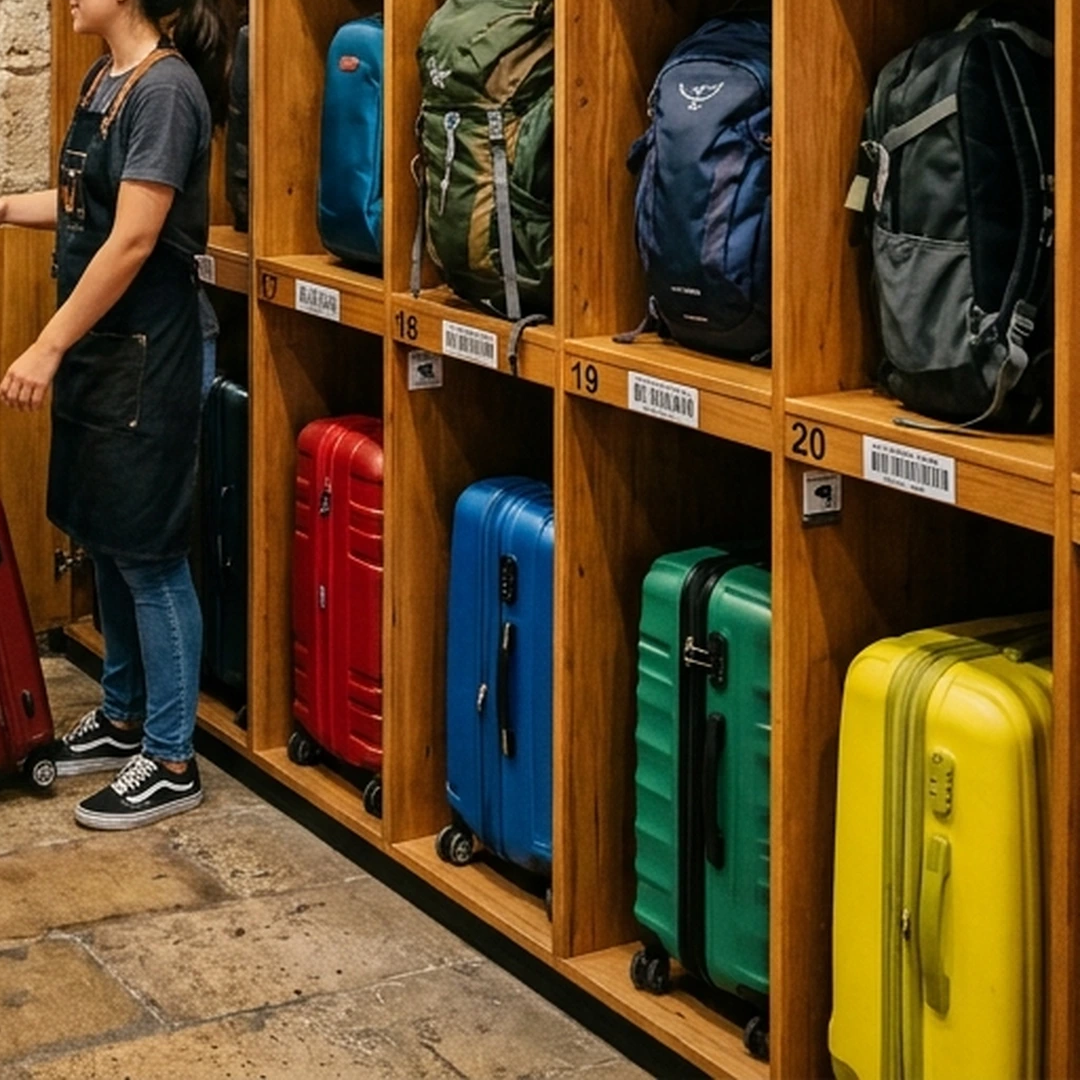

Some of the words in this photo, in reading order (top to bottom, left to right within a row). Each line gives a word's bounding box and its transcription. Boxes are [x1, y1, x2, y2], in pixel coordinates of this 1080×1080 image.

[395, 309, 418, 341] 18
[571, 361, 599, 394] 19
[792, 422, 826, 461] 20
